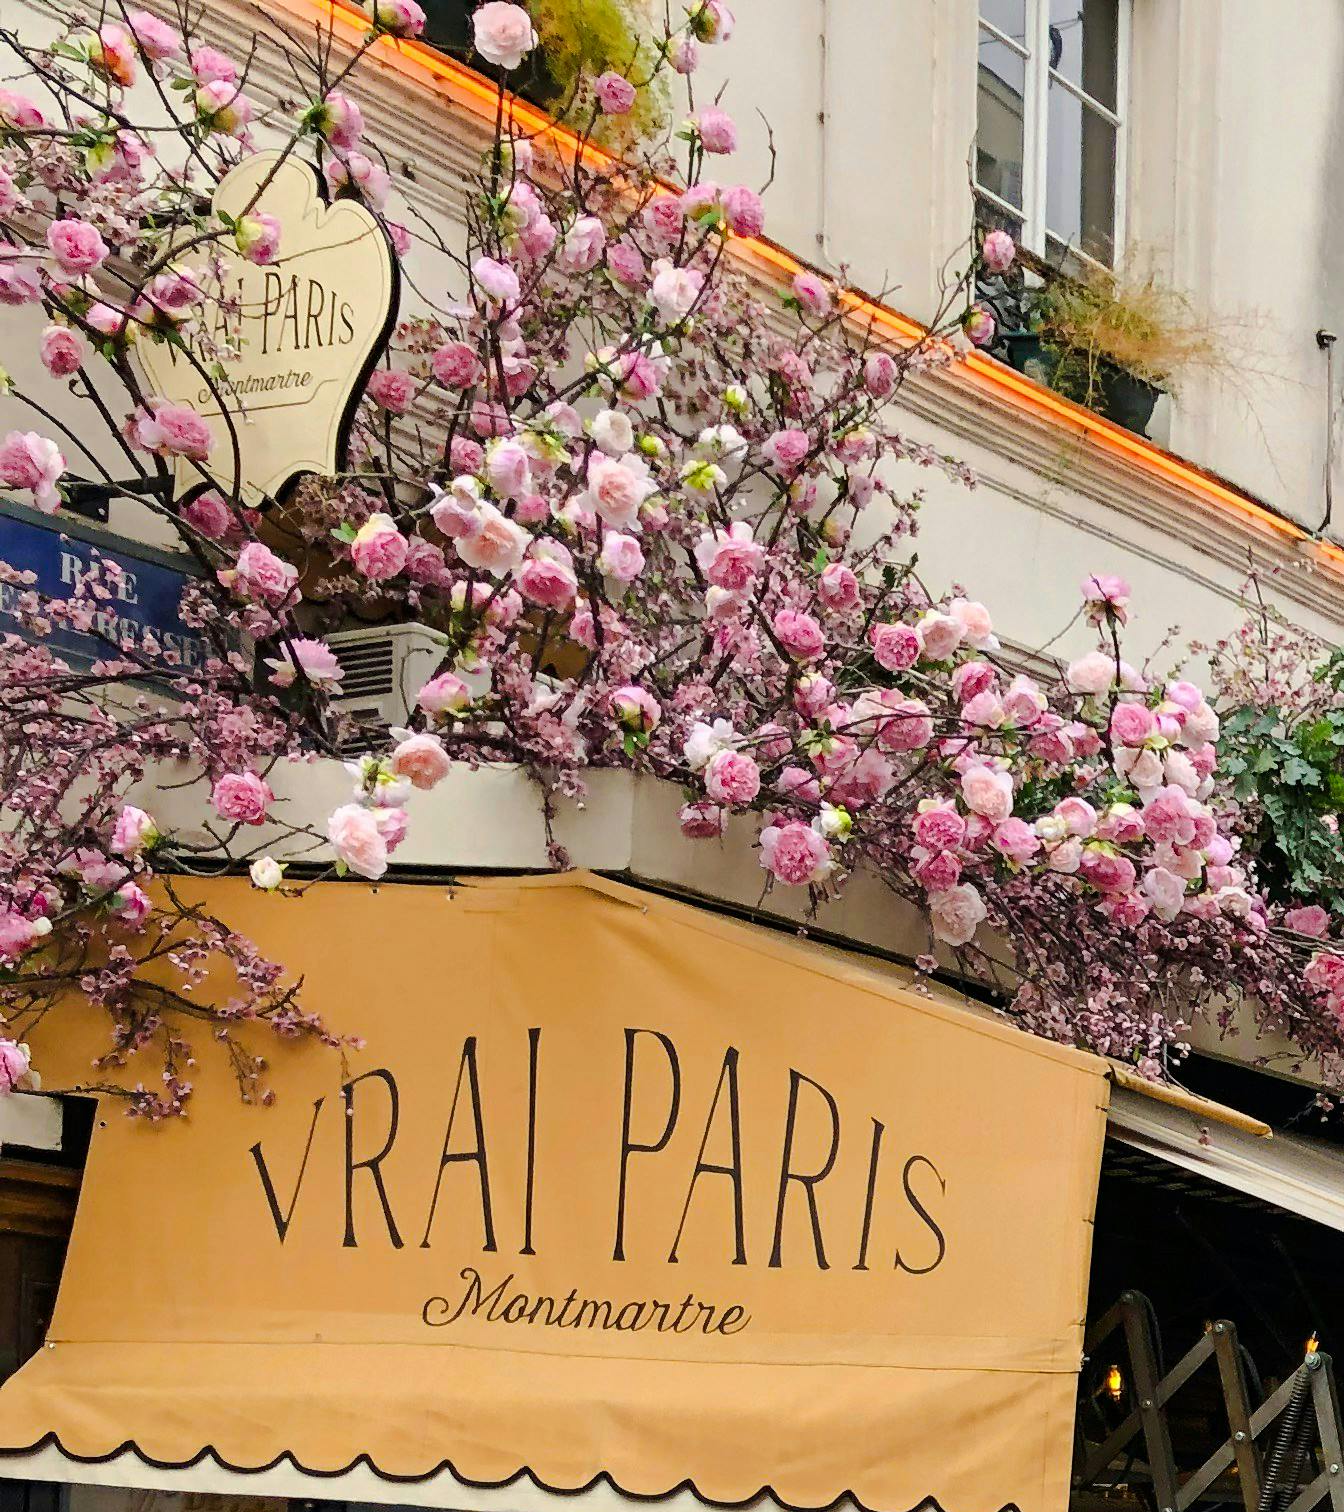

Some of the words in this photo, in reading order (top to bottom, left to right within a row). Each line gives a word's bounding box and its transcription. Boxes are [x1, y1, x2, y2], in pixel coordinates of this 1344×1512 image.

[166, 276, 245, 367] RAI
[261, 271, 355, 355] PARIS
[59, 551, 139, 605] RE
[247, 1027, 543, 1257] VRAI
[609, 1027, 949, 1275] PARIS
[421, 1266, 753, 1337] Montmartre
